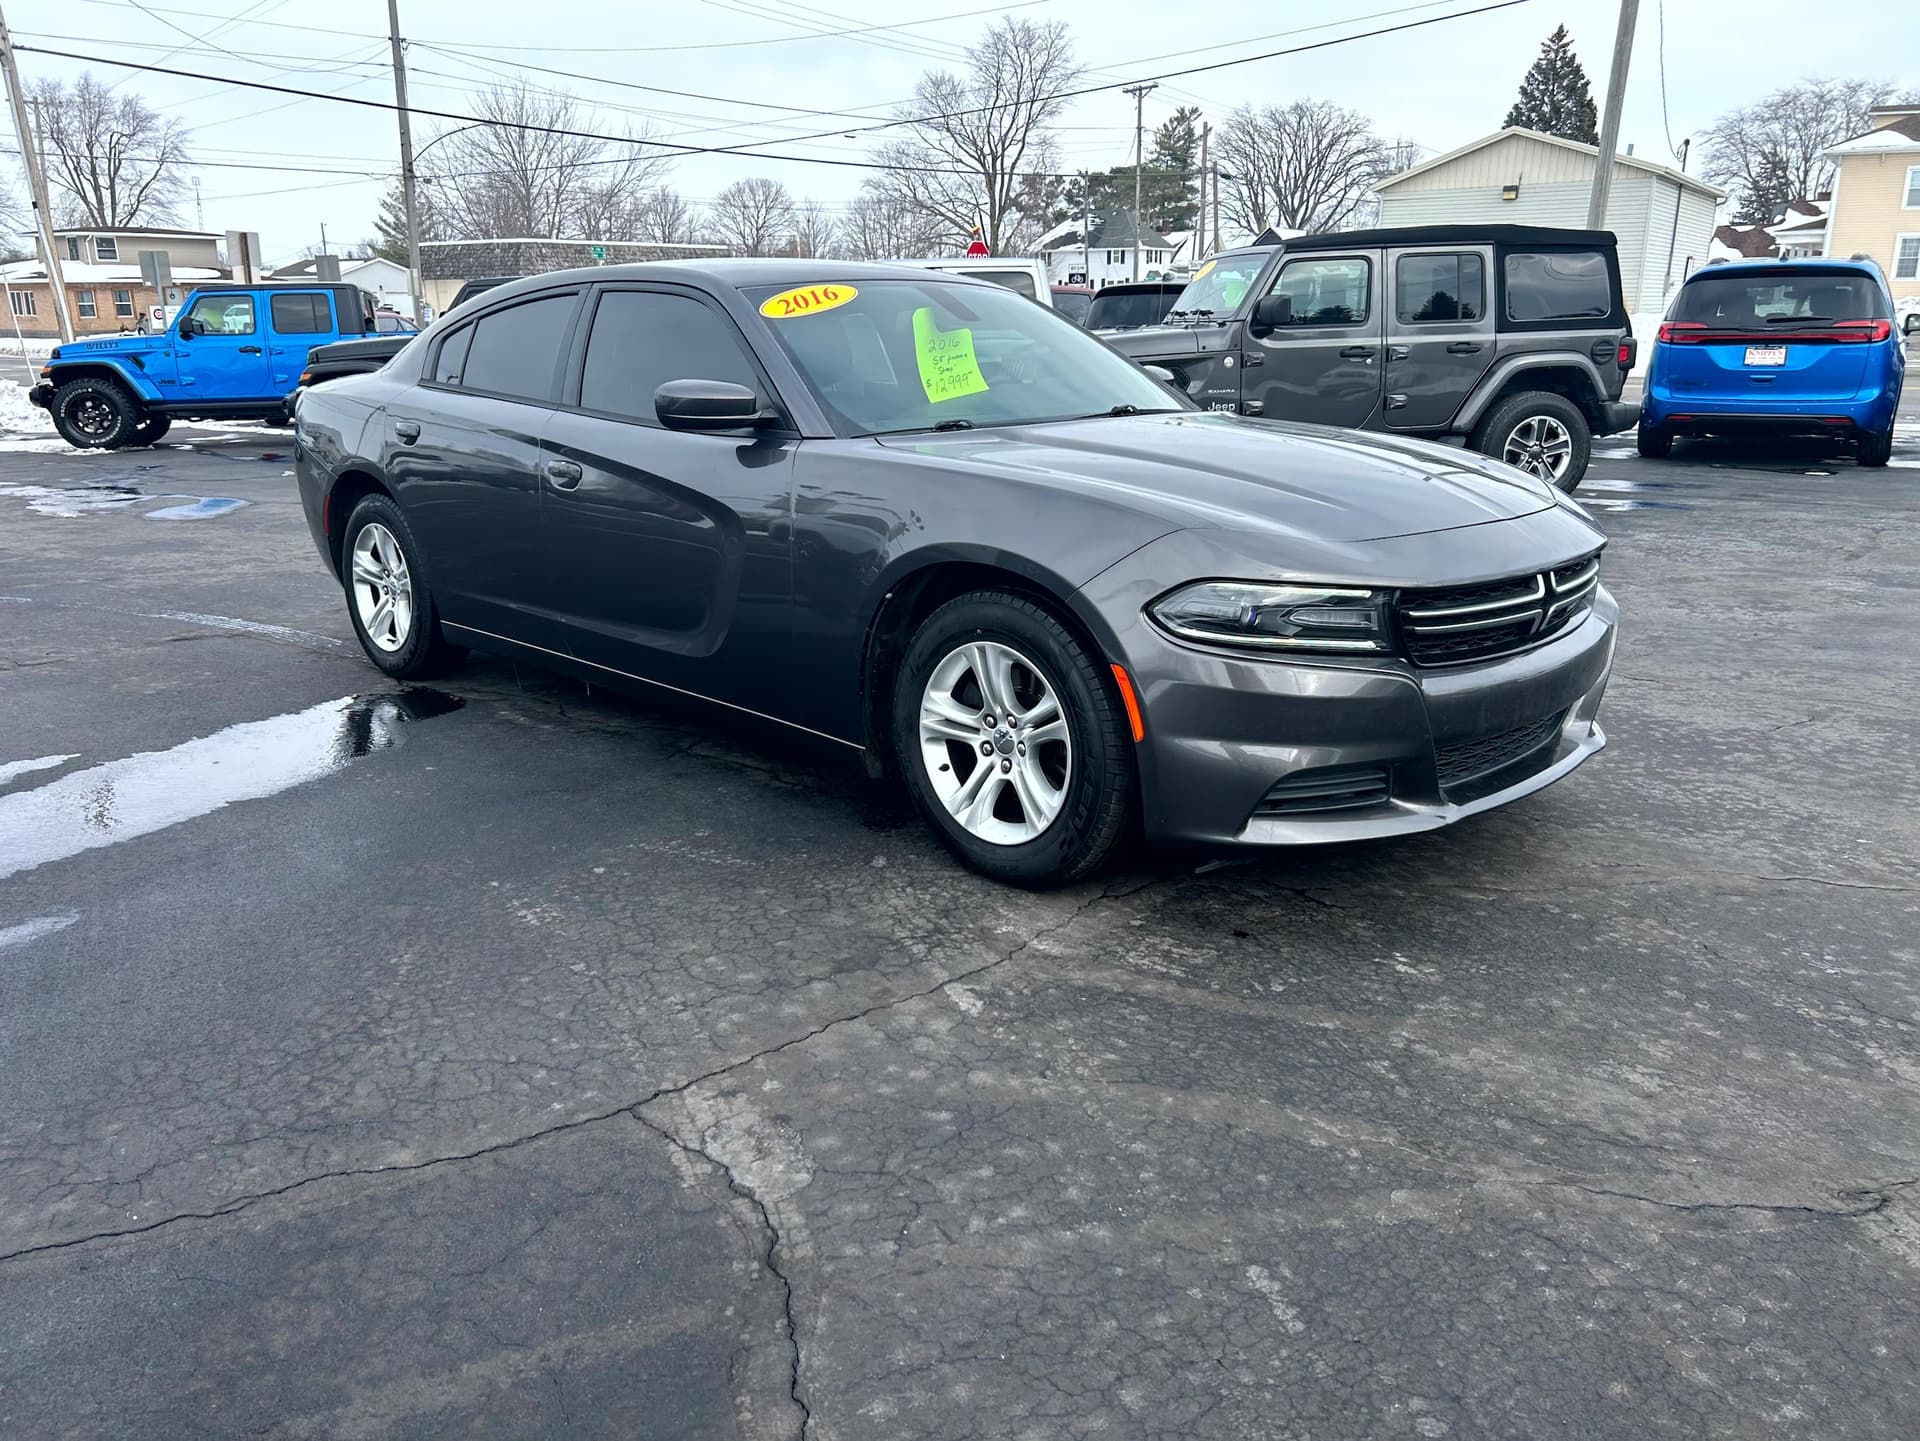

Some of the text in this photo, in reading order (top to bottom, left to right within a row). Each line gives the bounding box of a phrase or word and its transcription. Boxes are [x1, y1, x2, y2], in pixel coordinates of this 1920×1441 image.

[777, 287, 839, 315] 2016
[86, 341, 119, 351] WILLYS
[928, 336, 960, 353] 2016
[1208, 401, 1235, 411] Jeep
